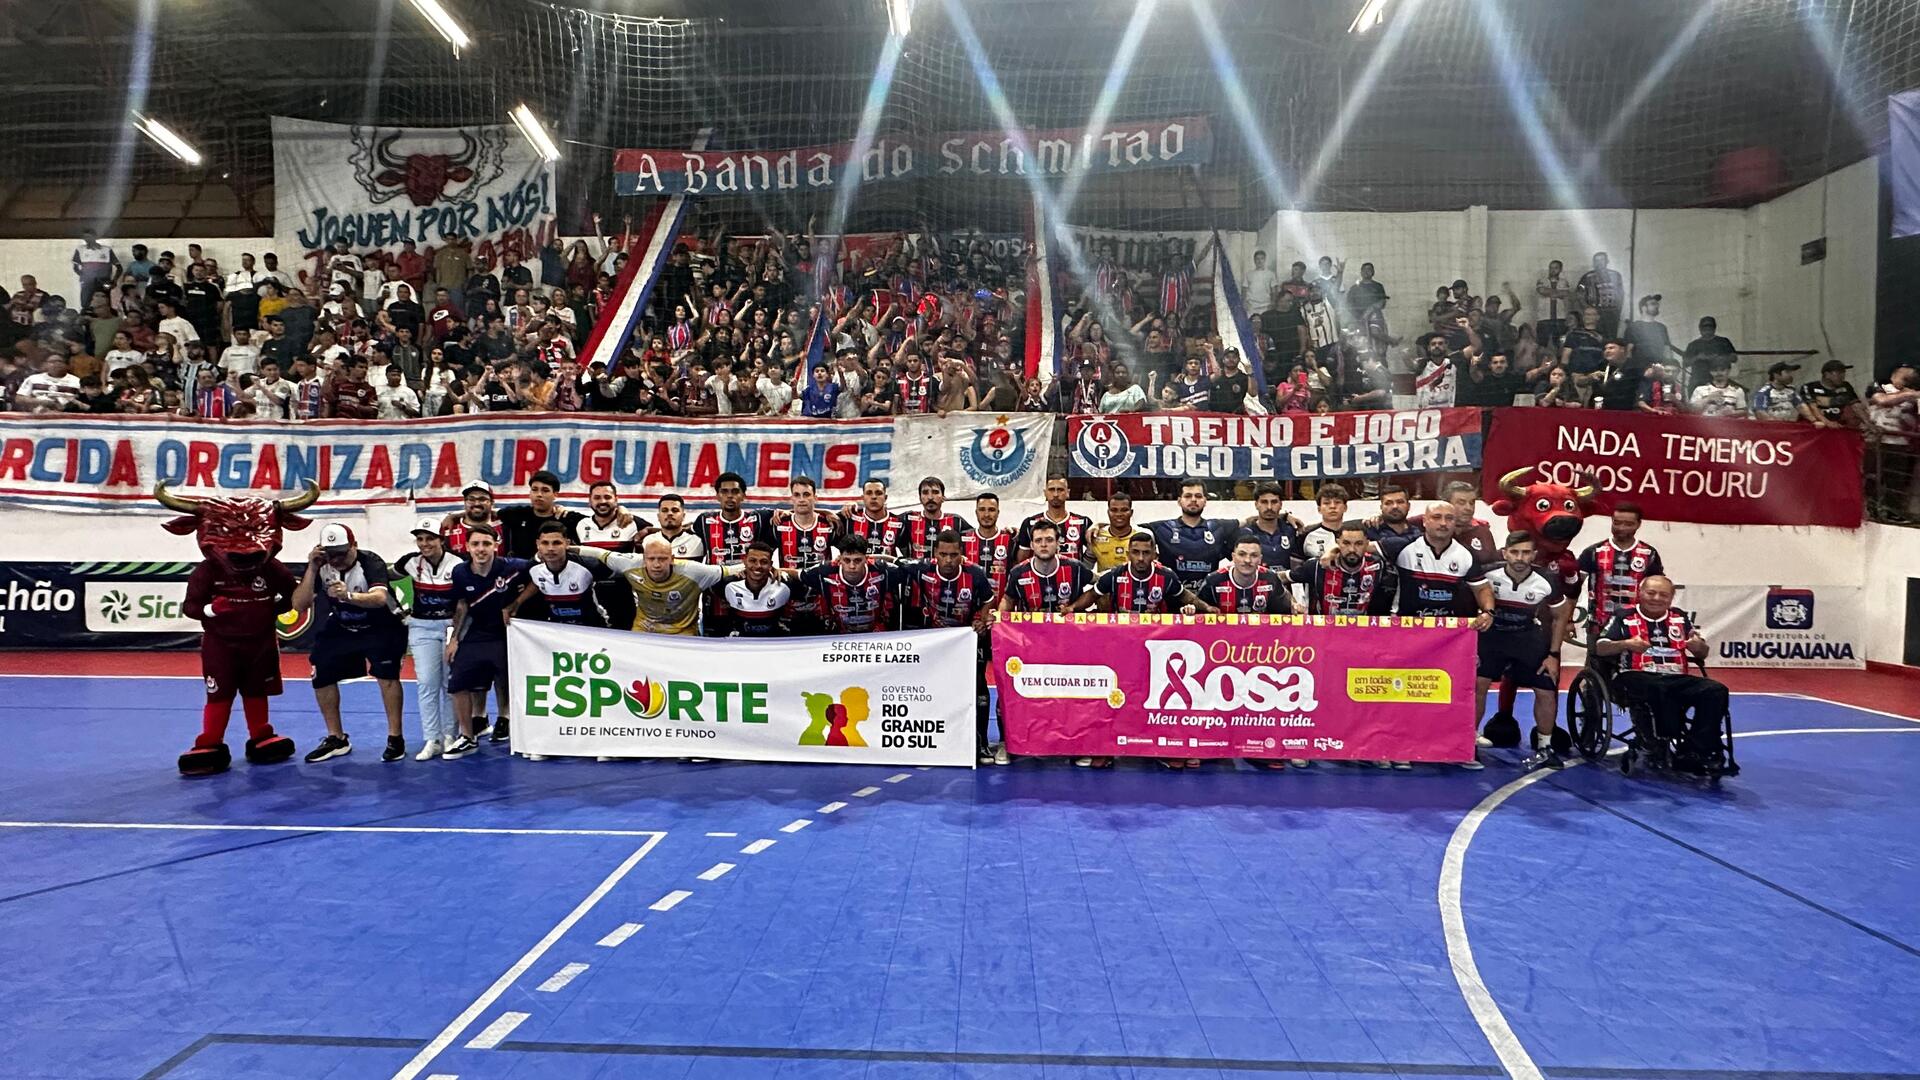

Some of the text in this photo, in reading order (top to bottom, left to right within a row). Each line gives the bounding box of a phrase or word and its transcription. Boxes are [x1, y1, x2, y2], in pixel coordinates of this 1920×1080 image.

[636, 153, 665, 192] A
[682, 150, 833, 194] Banda
[862, 139, 913, 181] do
[417, 201, 480, 242] POR
[487, 172, 550, 233] NÓS!
[1140, 409, 1442, 447] TREINO E JOGO
[1557, 425, 1794, 466] NADA TEMEMOS
[0, 437, 892, 489] RCIDA ORGANIZADA URUGUAIANENSE
[1139, 445, 1236, 477] JOGO
[1290, 435, 1470, 477] GUERRA
[831, 641, 912, 652] SECRETARIA DO
[1210, 639, 1316, 665] Outubro
[1720, 641, 1855, 660] URUGUAIANA
[552, 647, 611, 677] pró
[823, 653, 921, 664] ESPORTE E LAZER
[1021, 676, 1109, 688] VEM CUIDAR DE TI
[1143, 639, 1319, 712] Rosa
[1354, 675, 1392, 684] em todas
[882, 686, 926, 694] GOVERNO
[882, 694, 933, 702] DO ESTADO
[1407, 690, 1431, 698] Mulher
[526, 674, 769, 724] ESPORTE
[882, 704, 909, 718] RIO
[882, 718, 946, 734] GRANDE
[1147, 713, 1315, 729] Meu corpo, minha vida.
[559, 726, 716, 739] LEI DE INCENTIVO E FUNDO
[882, 734, 937, 749] DO SUL
